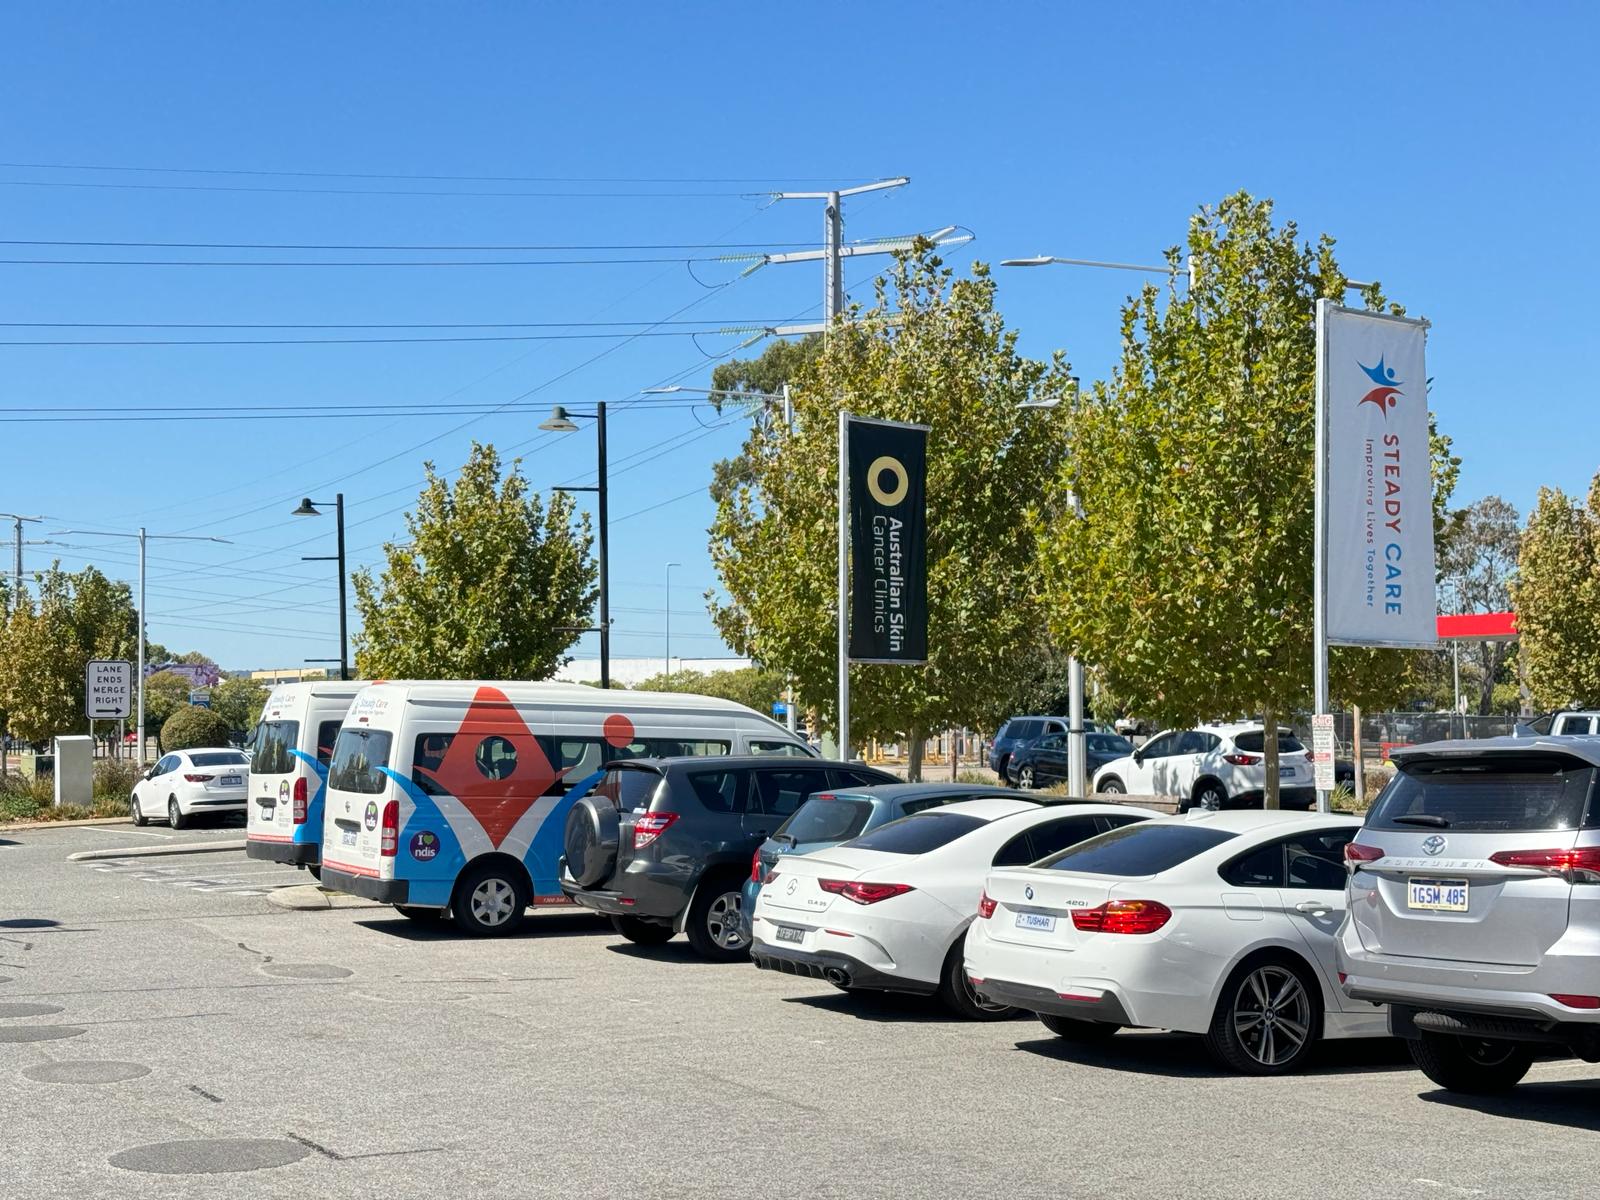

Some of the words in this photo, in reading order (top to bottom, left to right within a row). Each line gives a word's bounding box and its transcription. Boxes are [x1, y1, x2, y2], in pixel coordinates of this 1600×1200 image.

[1365, 438, 1375, 507] Improving
[1383, 434, 1402, 534] STEADY
[873, 515, 887, 574] Cancer
[1366, 511, 1375, 544] Lives
[889, 516, 905, 608] Australian
[1365, 550, 1376, 607] Together
[1385, 543, 1402, 615] CARE
[874, 578, 888, 634] Clinics
[889, 613, 906, 652] Skin
[93, 686, 126, 694] MERGE
[415, 847, 436, 857] ndis
[418, 834, 423, 845] I
[1383, 859, 1485, 868] FORTUNER
[1412, 887, 1440, 904] 1GSM
[1445, 888, 1466, 906] 485
[1026, 915, 1050, 928] TUSHAR
